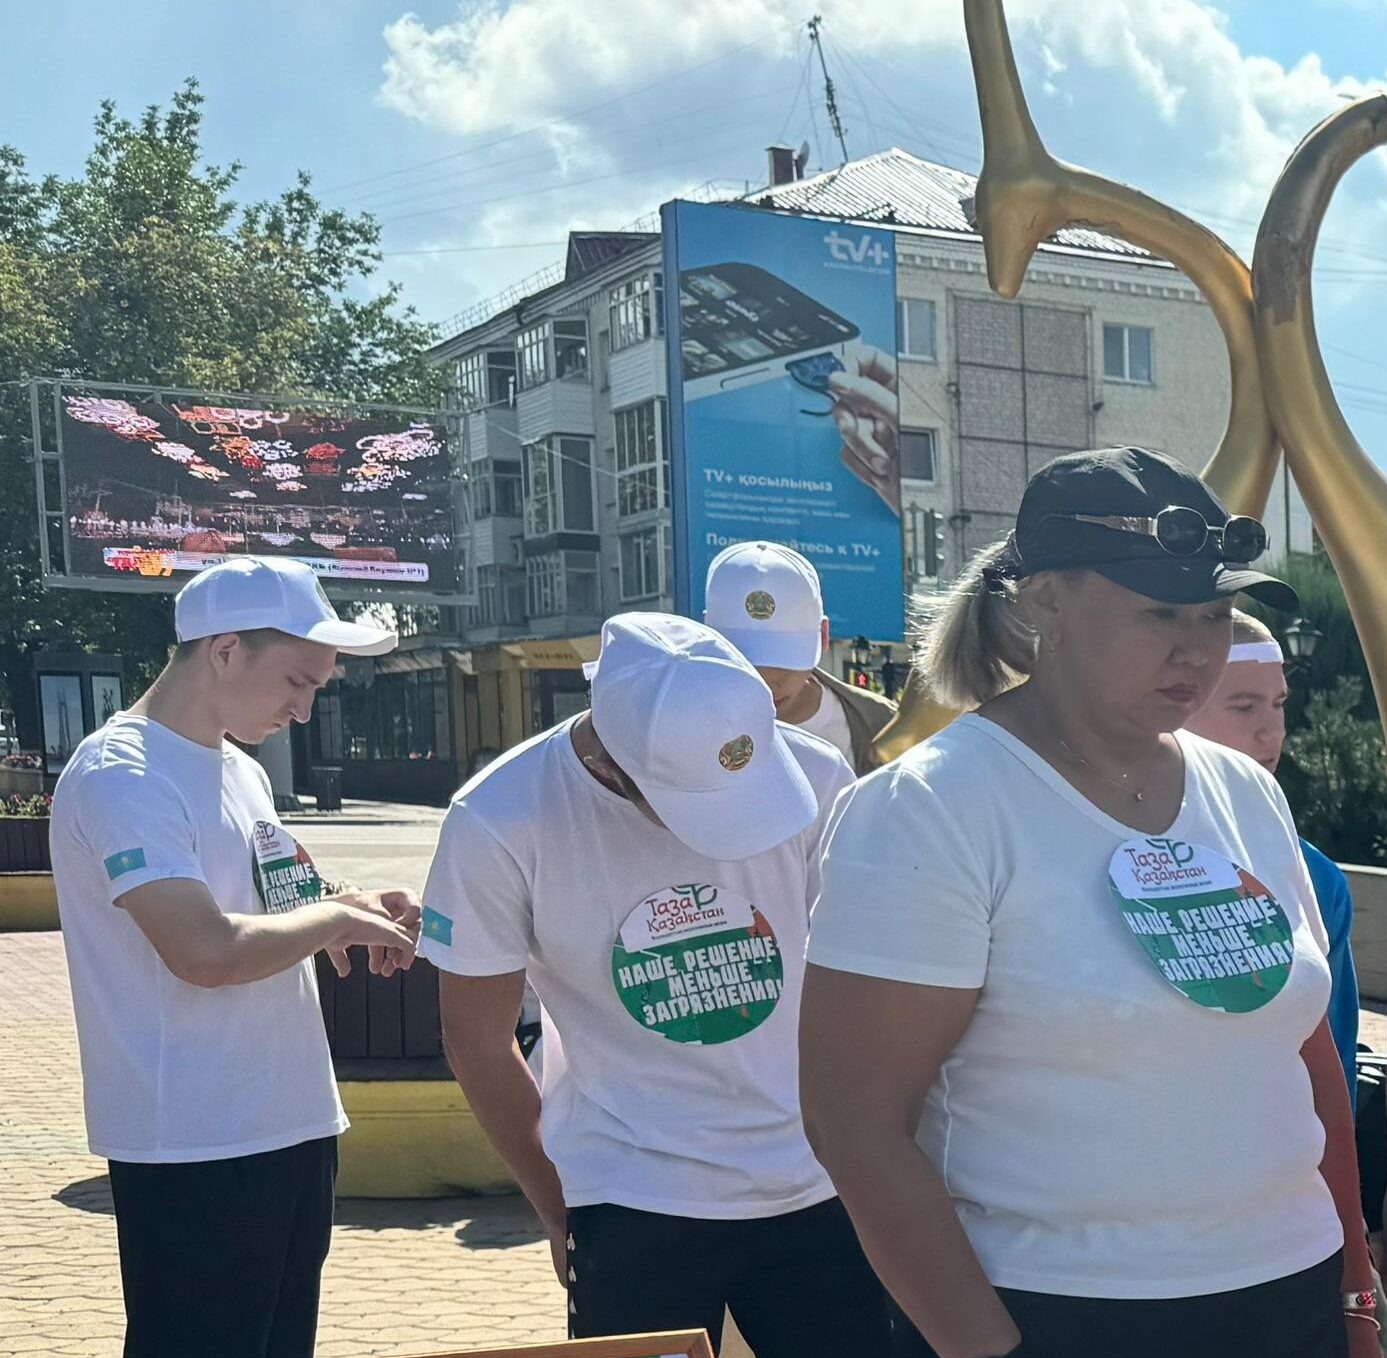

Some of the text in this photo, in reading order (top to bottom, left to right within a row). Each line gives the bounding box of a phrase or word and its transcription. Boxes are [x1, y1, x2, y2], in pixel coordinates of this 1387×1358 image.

[704, 469, 833, 492] TV+ қосылыңыз
[852, 544, 880, 558] TV+
[1124, 848, 1174, 871] Таза
[1131, 865, 1207, 885] Қазақстан
[645, 896, 694, 917] Таза
[646, 907, 725, 934] Қазақстан
[1122, 894, 1278, 935] НАШЕ РЕШЕНИЕ
[1171, 924, 1257, 958] МЕНЬШЕ
[618, 935, 777, 989] НАШЕ РЕШЕНИЕ
[1158, 939, 1295, 982] ЗАГРЯЗНЕНИЯ!
[668, 961, 753, 1000] МЕНЬШЕ
[642, 978, 783, 1026] ЗАГРЯЗНЕНИЯ!
